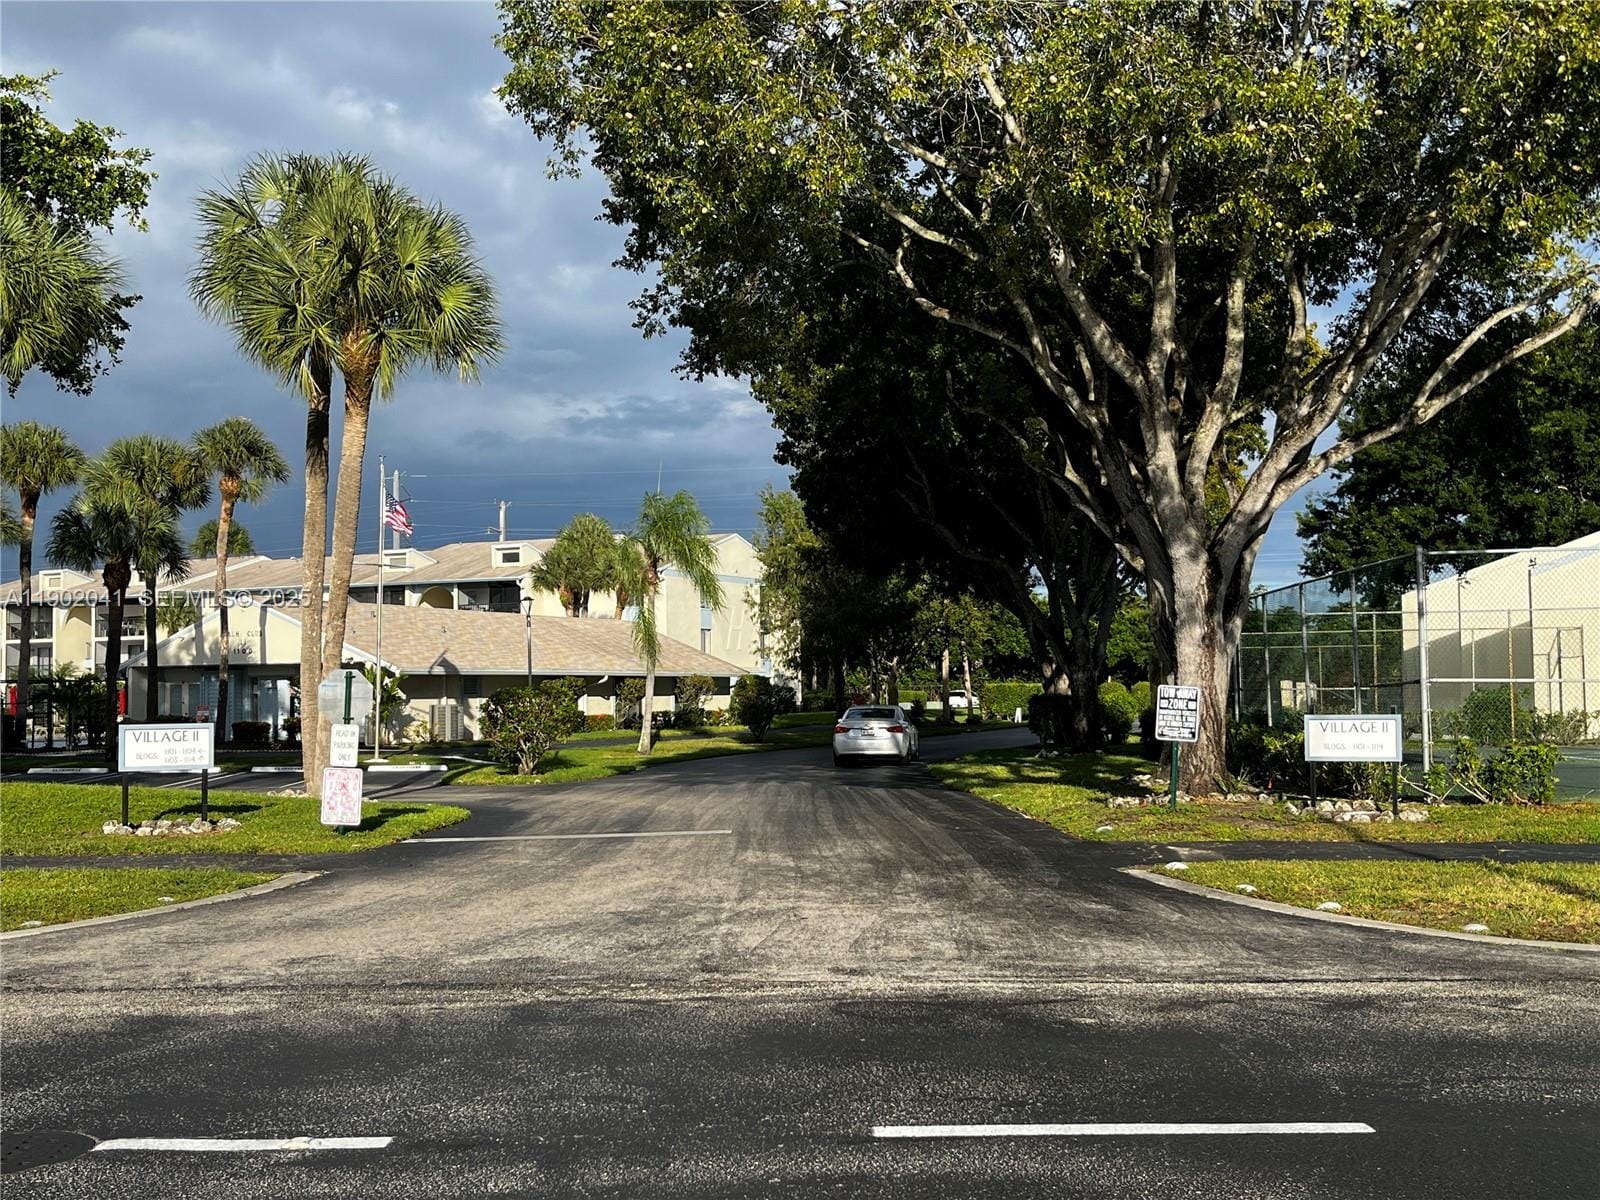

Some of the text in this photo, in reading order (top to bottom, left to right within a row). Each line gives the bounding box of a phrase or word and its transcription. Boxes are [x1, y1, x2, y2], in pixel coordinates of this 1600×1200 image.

[1168, 698, 1188, 710] ZONE
[1319, 721, 1389, 733] VILLAGE II
[132, 730, 199, 743] VILLAGE II
